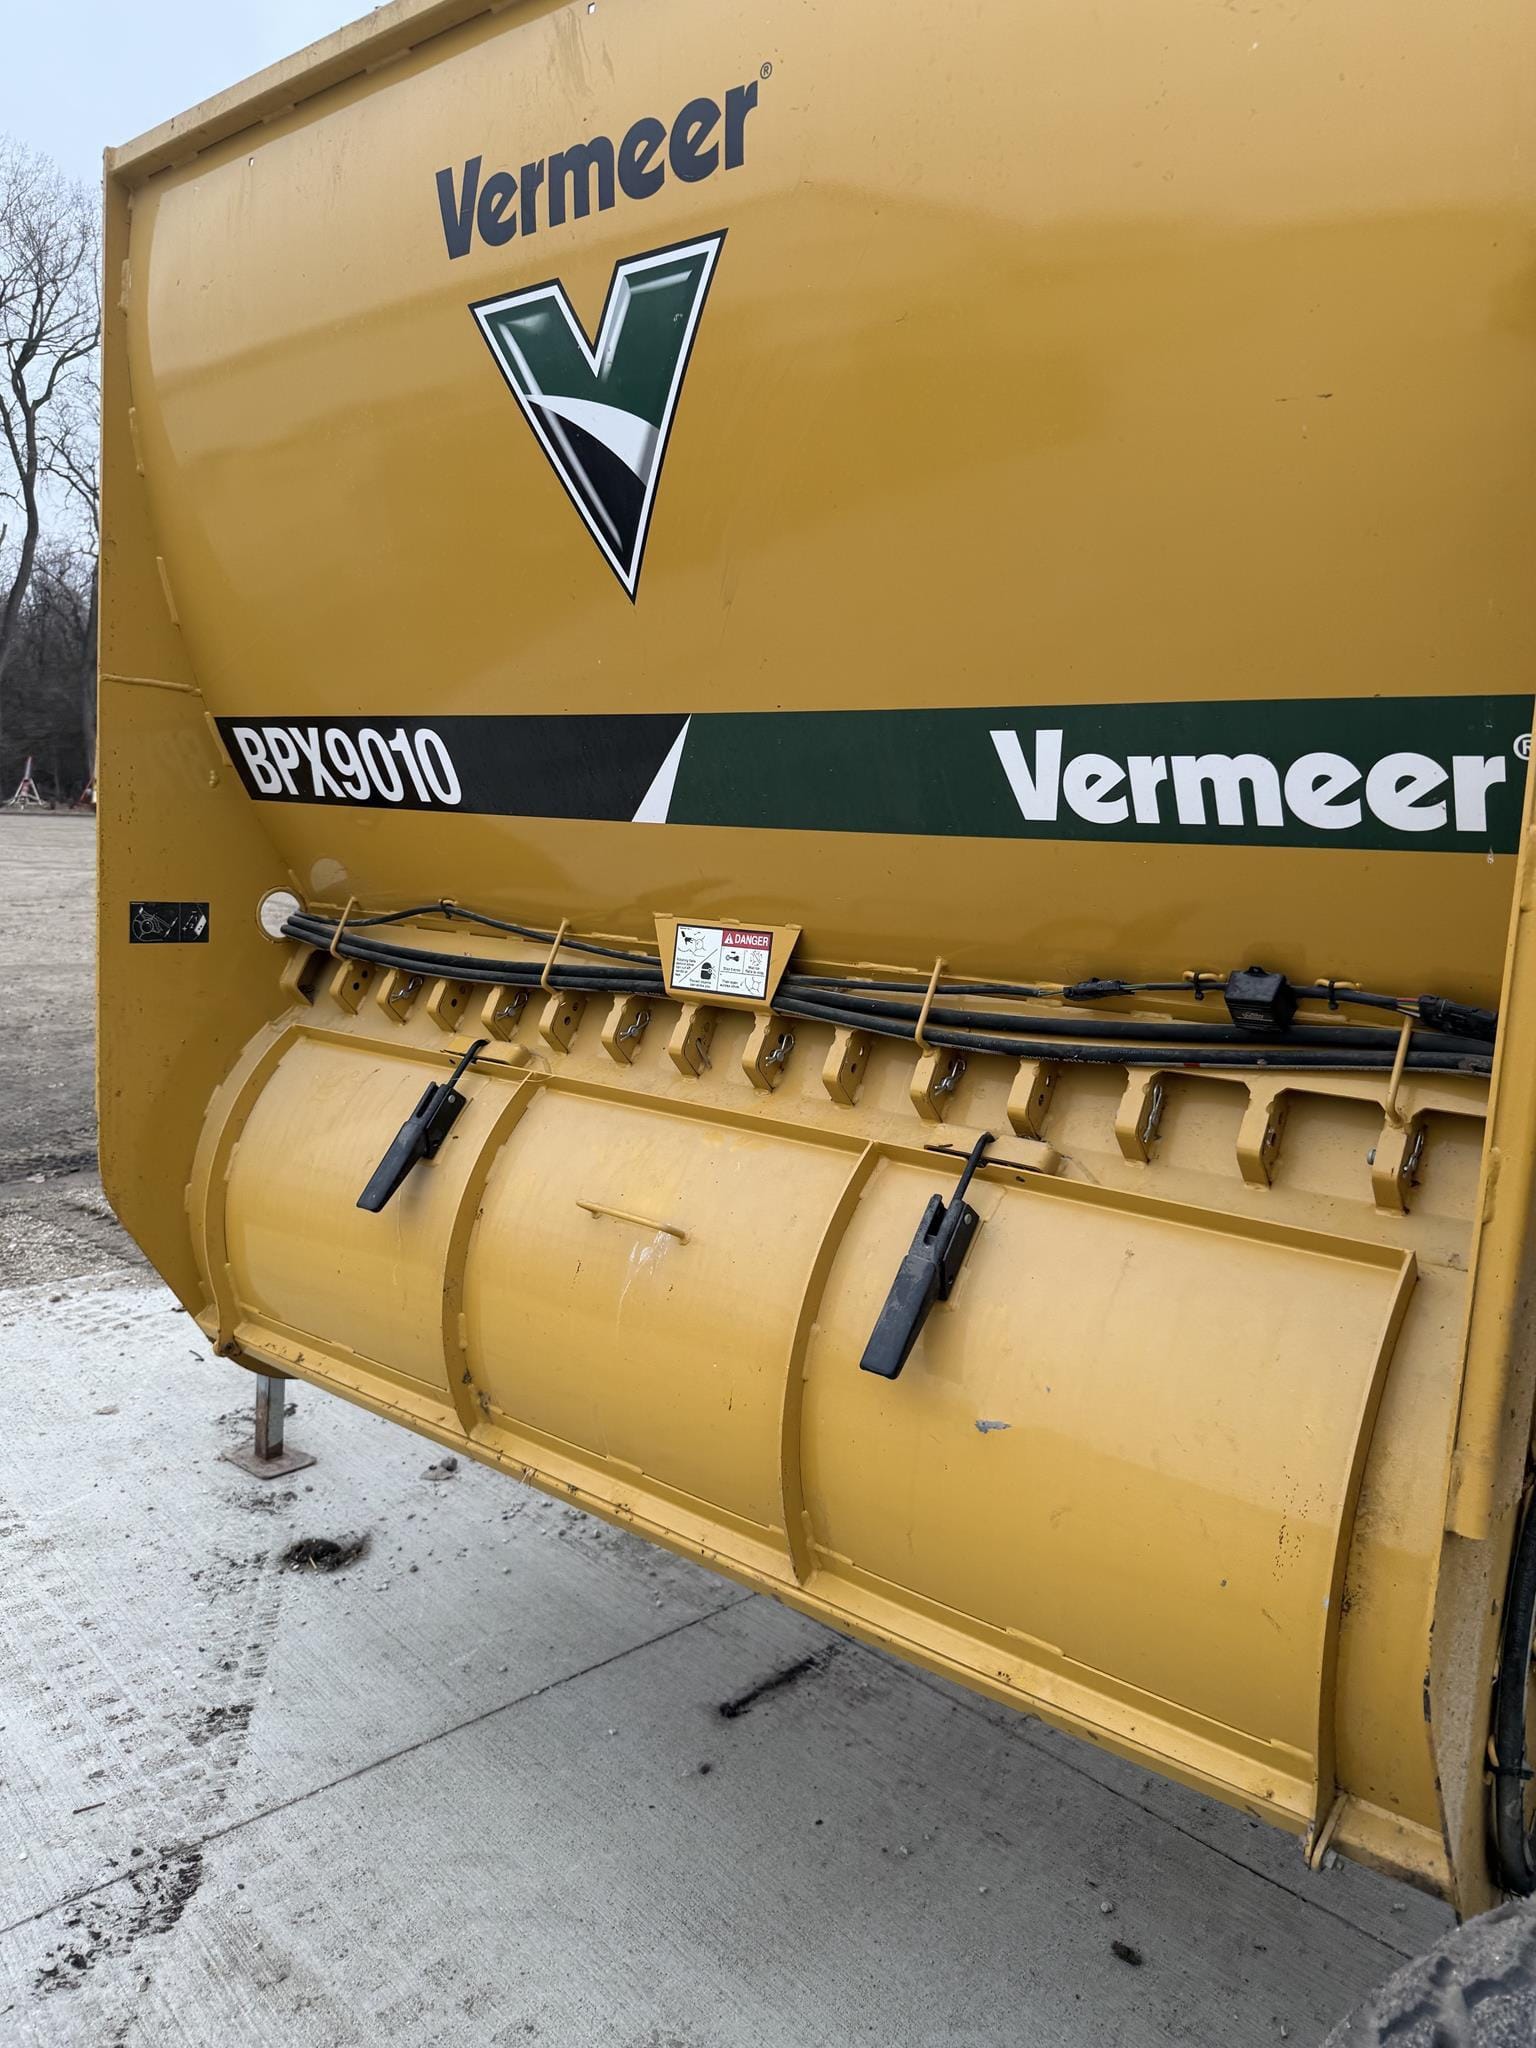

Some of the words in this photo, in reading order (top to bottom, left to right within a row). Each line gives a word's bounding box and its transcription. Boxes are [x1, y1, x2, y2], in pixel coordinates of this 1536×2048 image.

[436, 80, 758, 260] Vermeer
[232, 727, 462, 805] BPX9010
[989, 729, 1506, 832] Vermeer
[734, 934, 769, 947] DANGER
